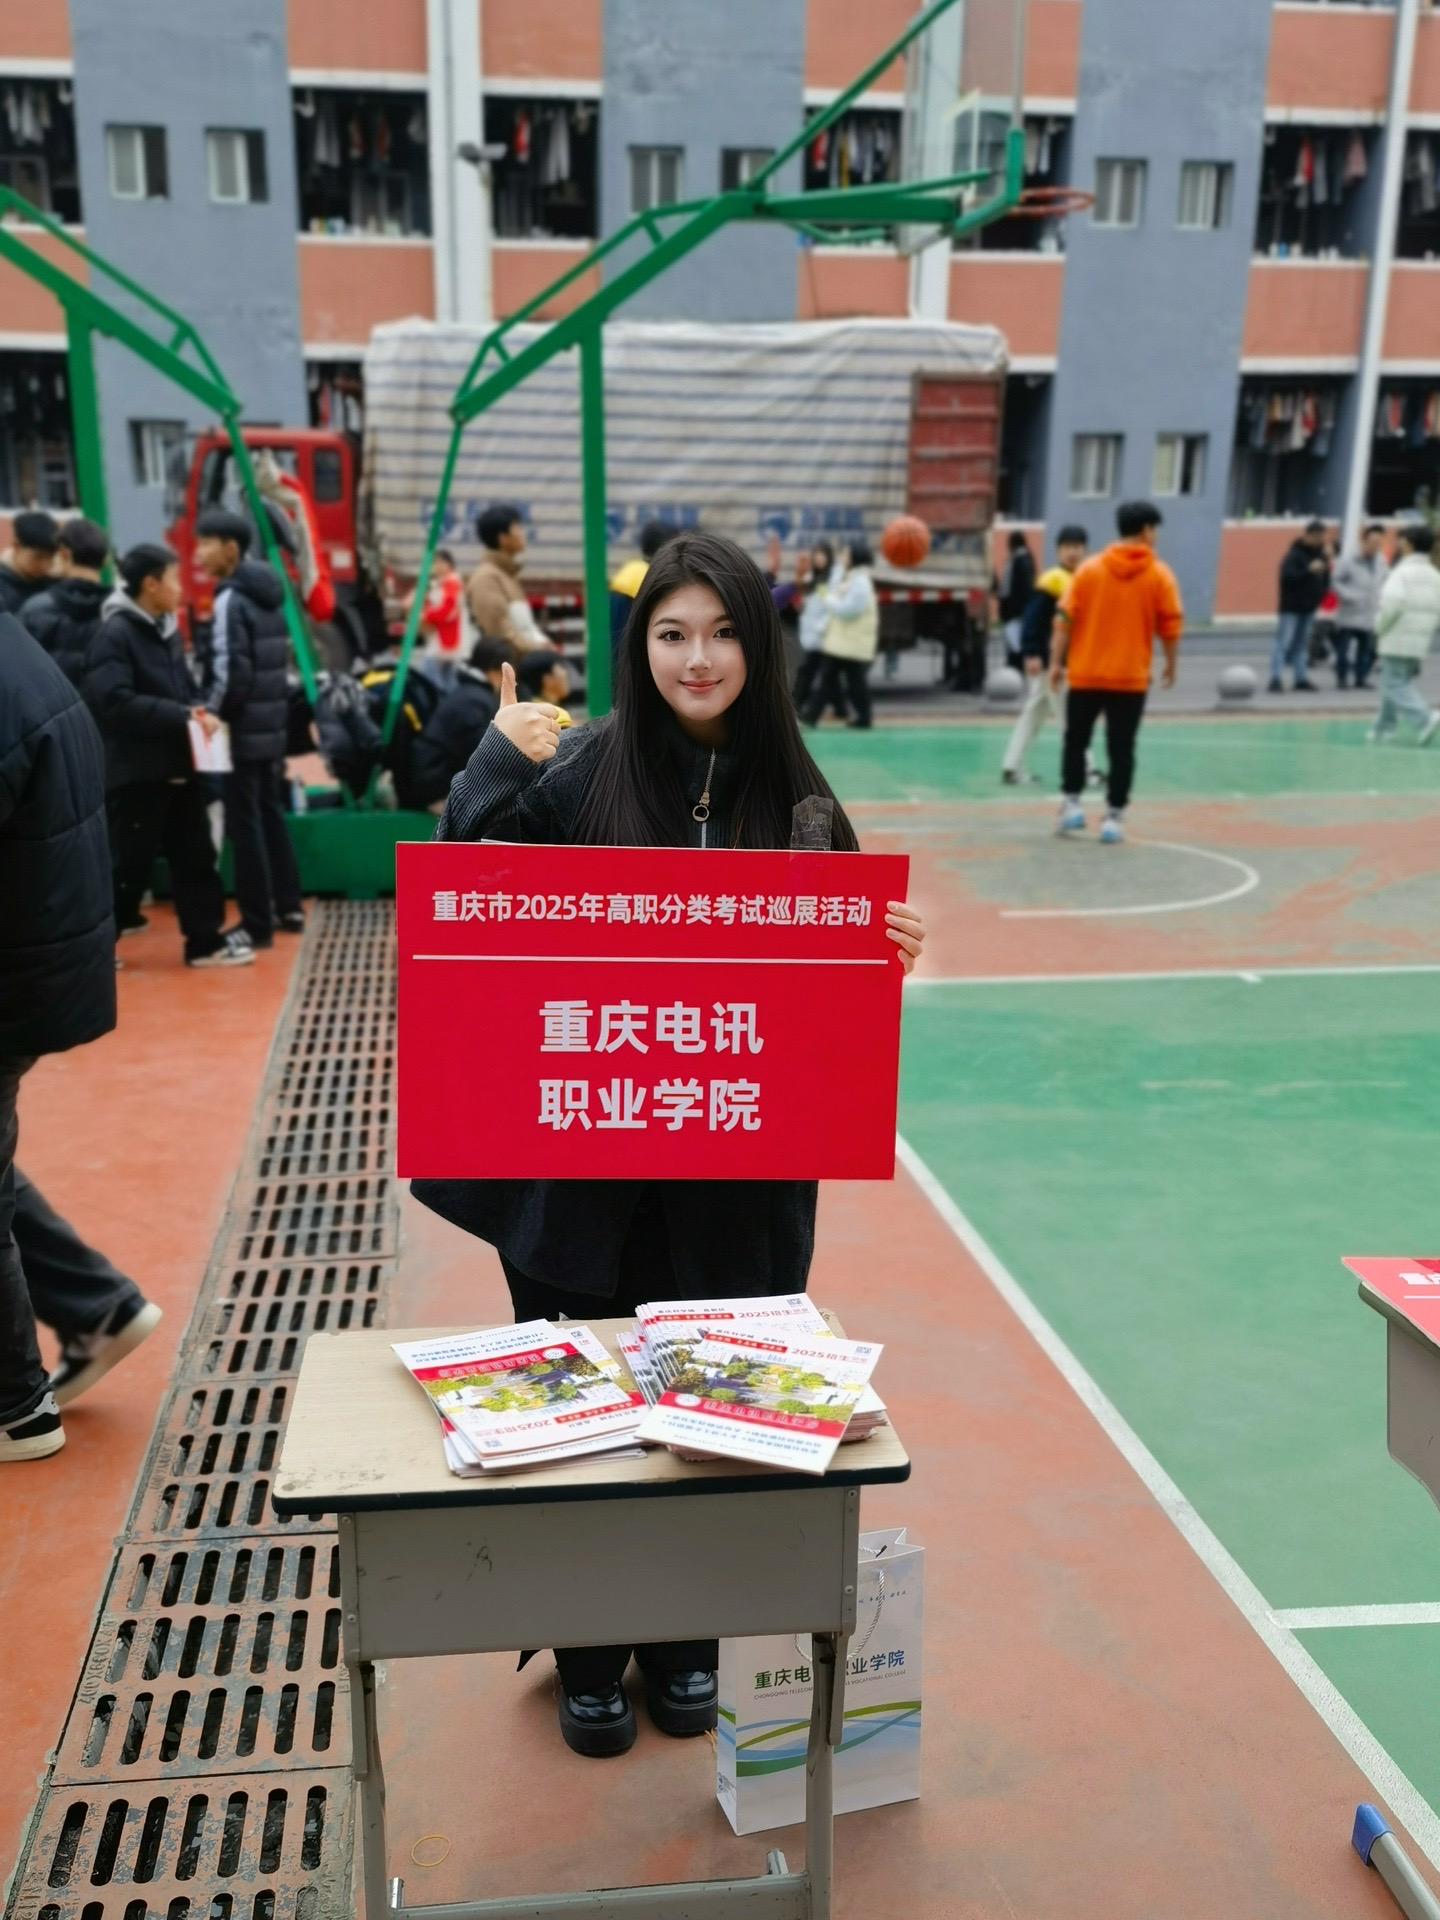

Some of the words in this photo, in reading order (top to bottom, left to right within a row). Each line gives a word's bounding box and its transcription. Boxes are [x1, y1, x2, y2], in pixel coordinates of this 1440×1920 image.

[432, 891, 871, 926] 重庆市2025年高职分类考试巡展活动
[539, 1000, 764, 1054] 重庆电讯
[538, 1078, 762, 1131] 职业学院
[754, 1650, 905, 1690] 重庆电业学院
